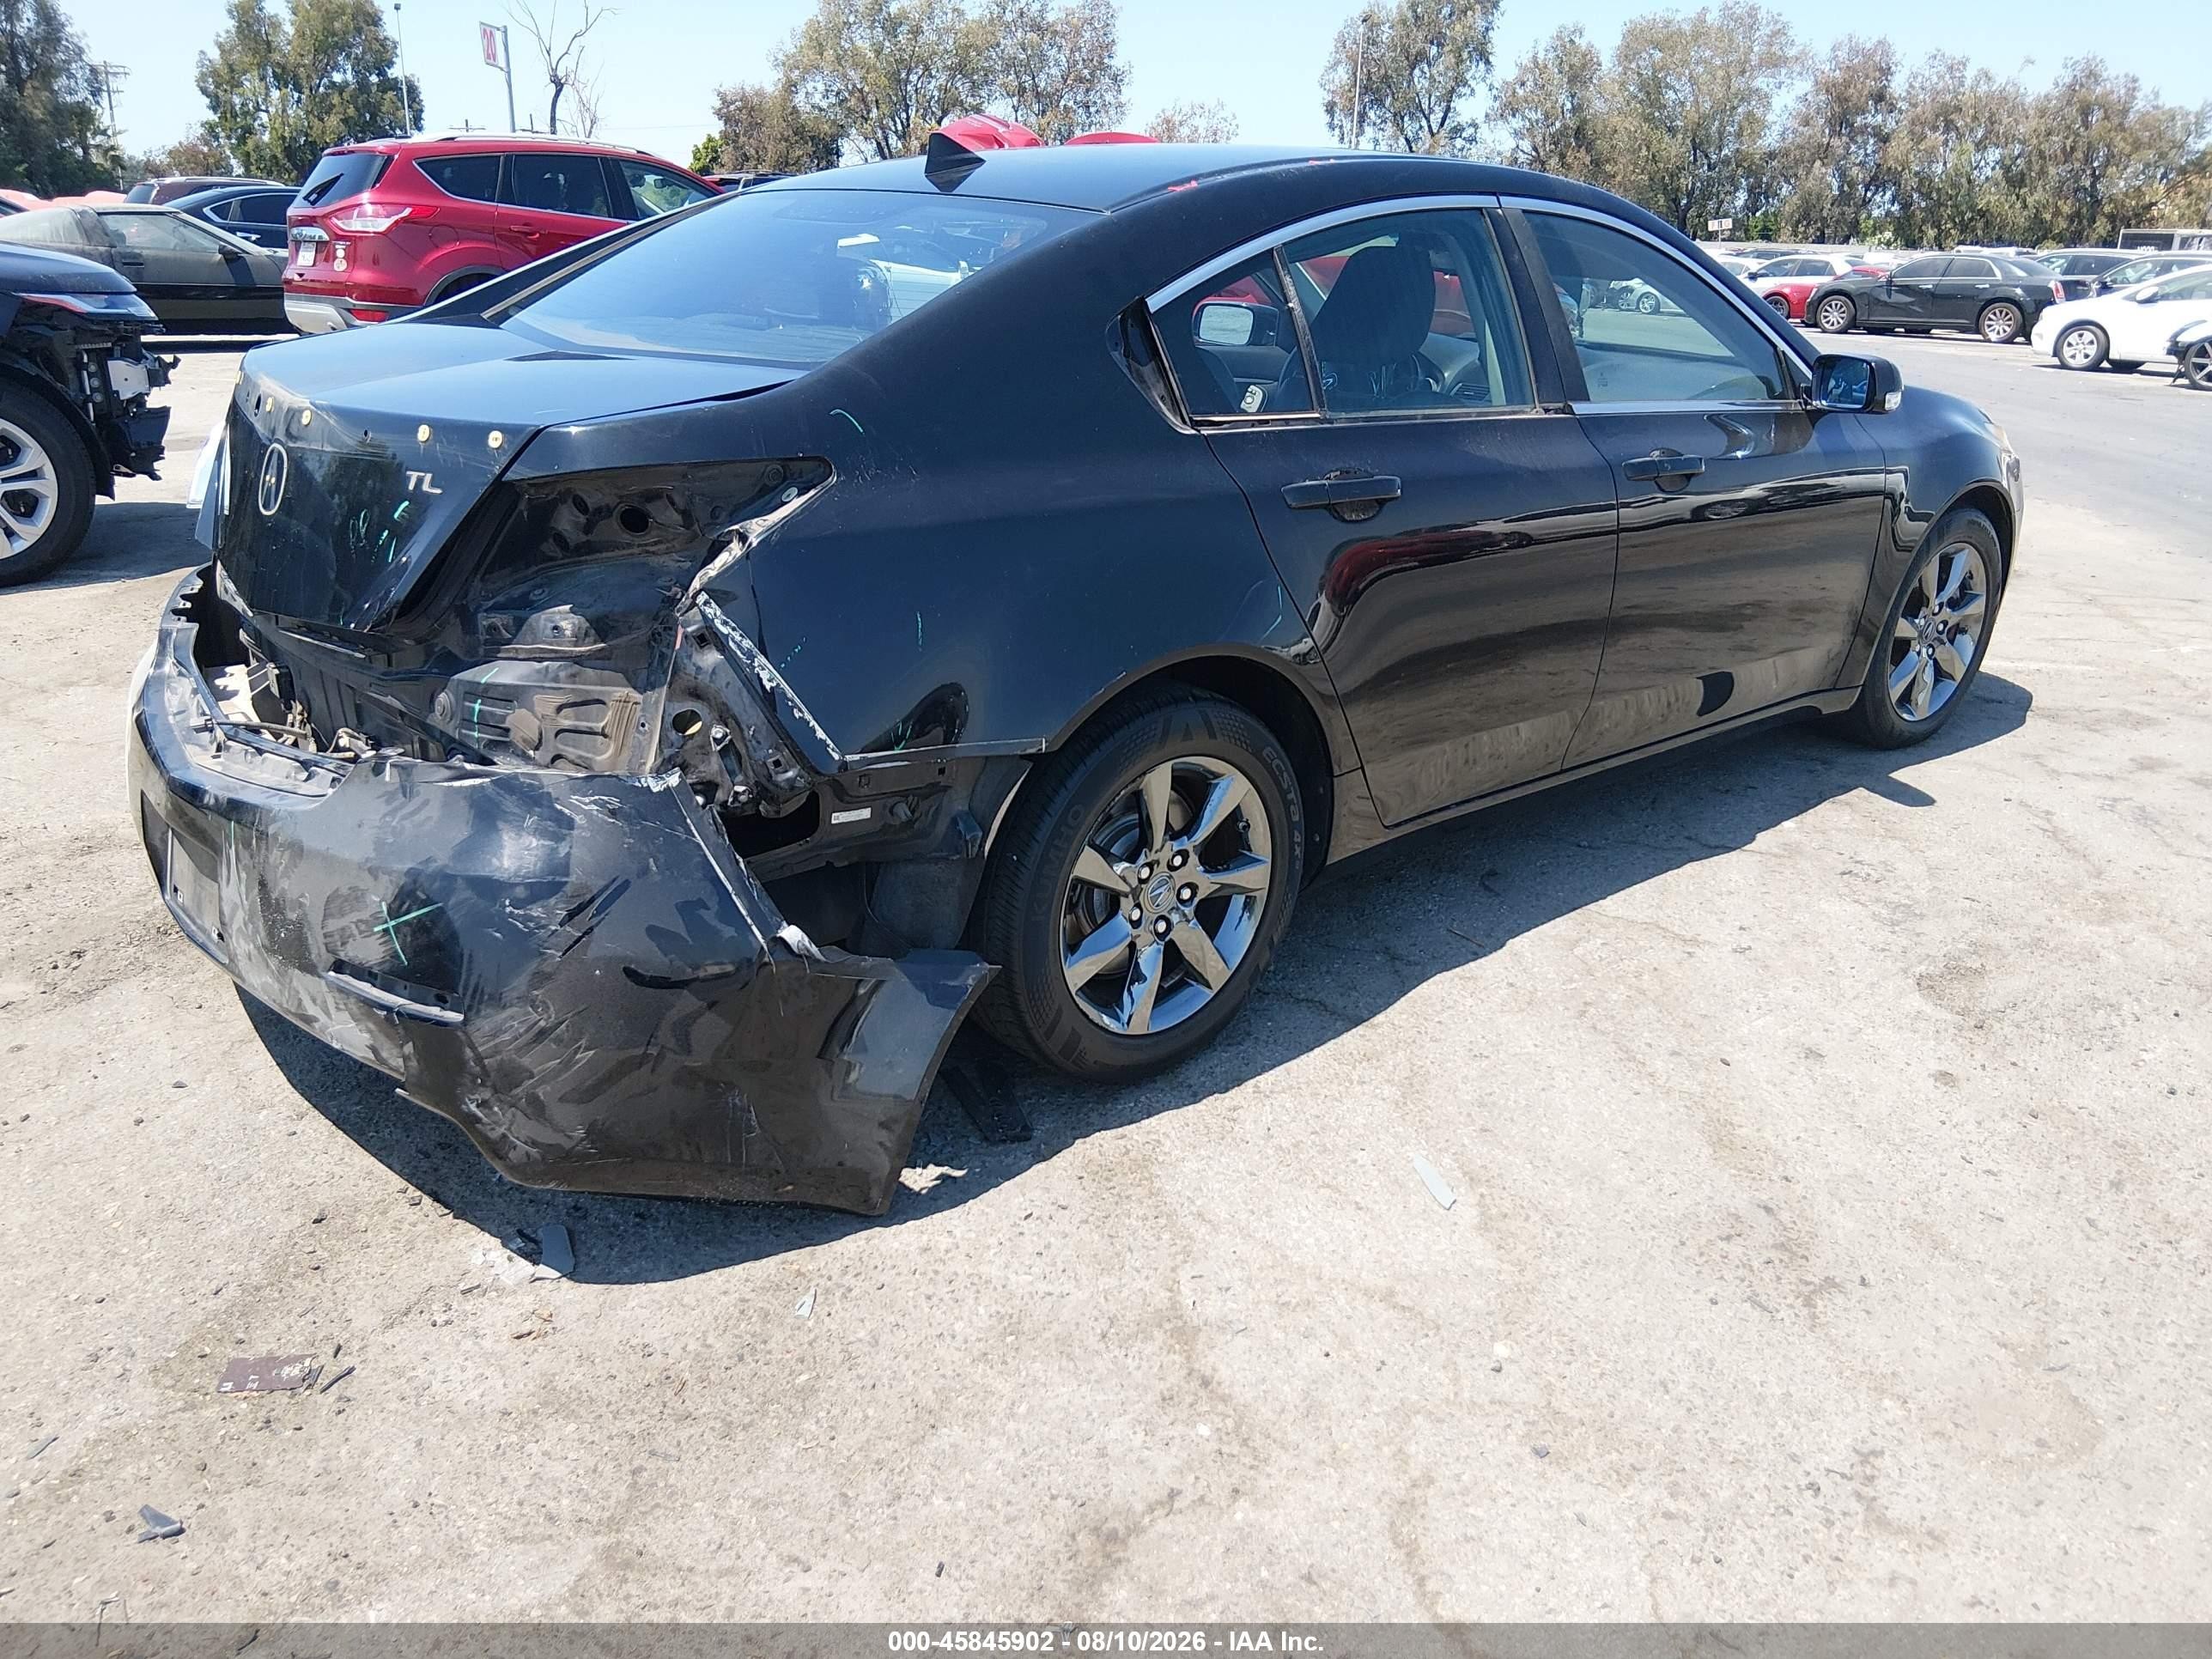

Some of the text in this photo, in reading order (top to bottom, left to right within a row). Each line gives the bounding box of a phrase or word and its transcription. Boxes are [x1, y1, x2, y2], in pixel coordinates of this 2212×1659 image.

[483, 27, 496, 63] 20
[406, 471, 443, 494] TL
[1031, 804, 1085, 921] KUMHO
